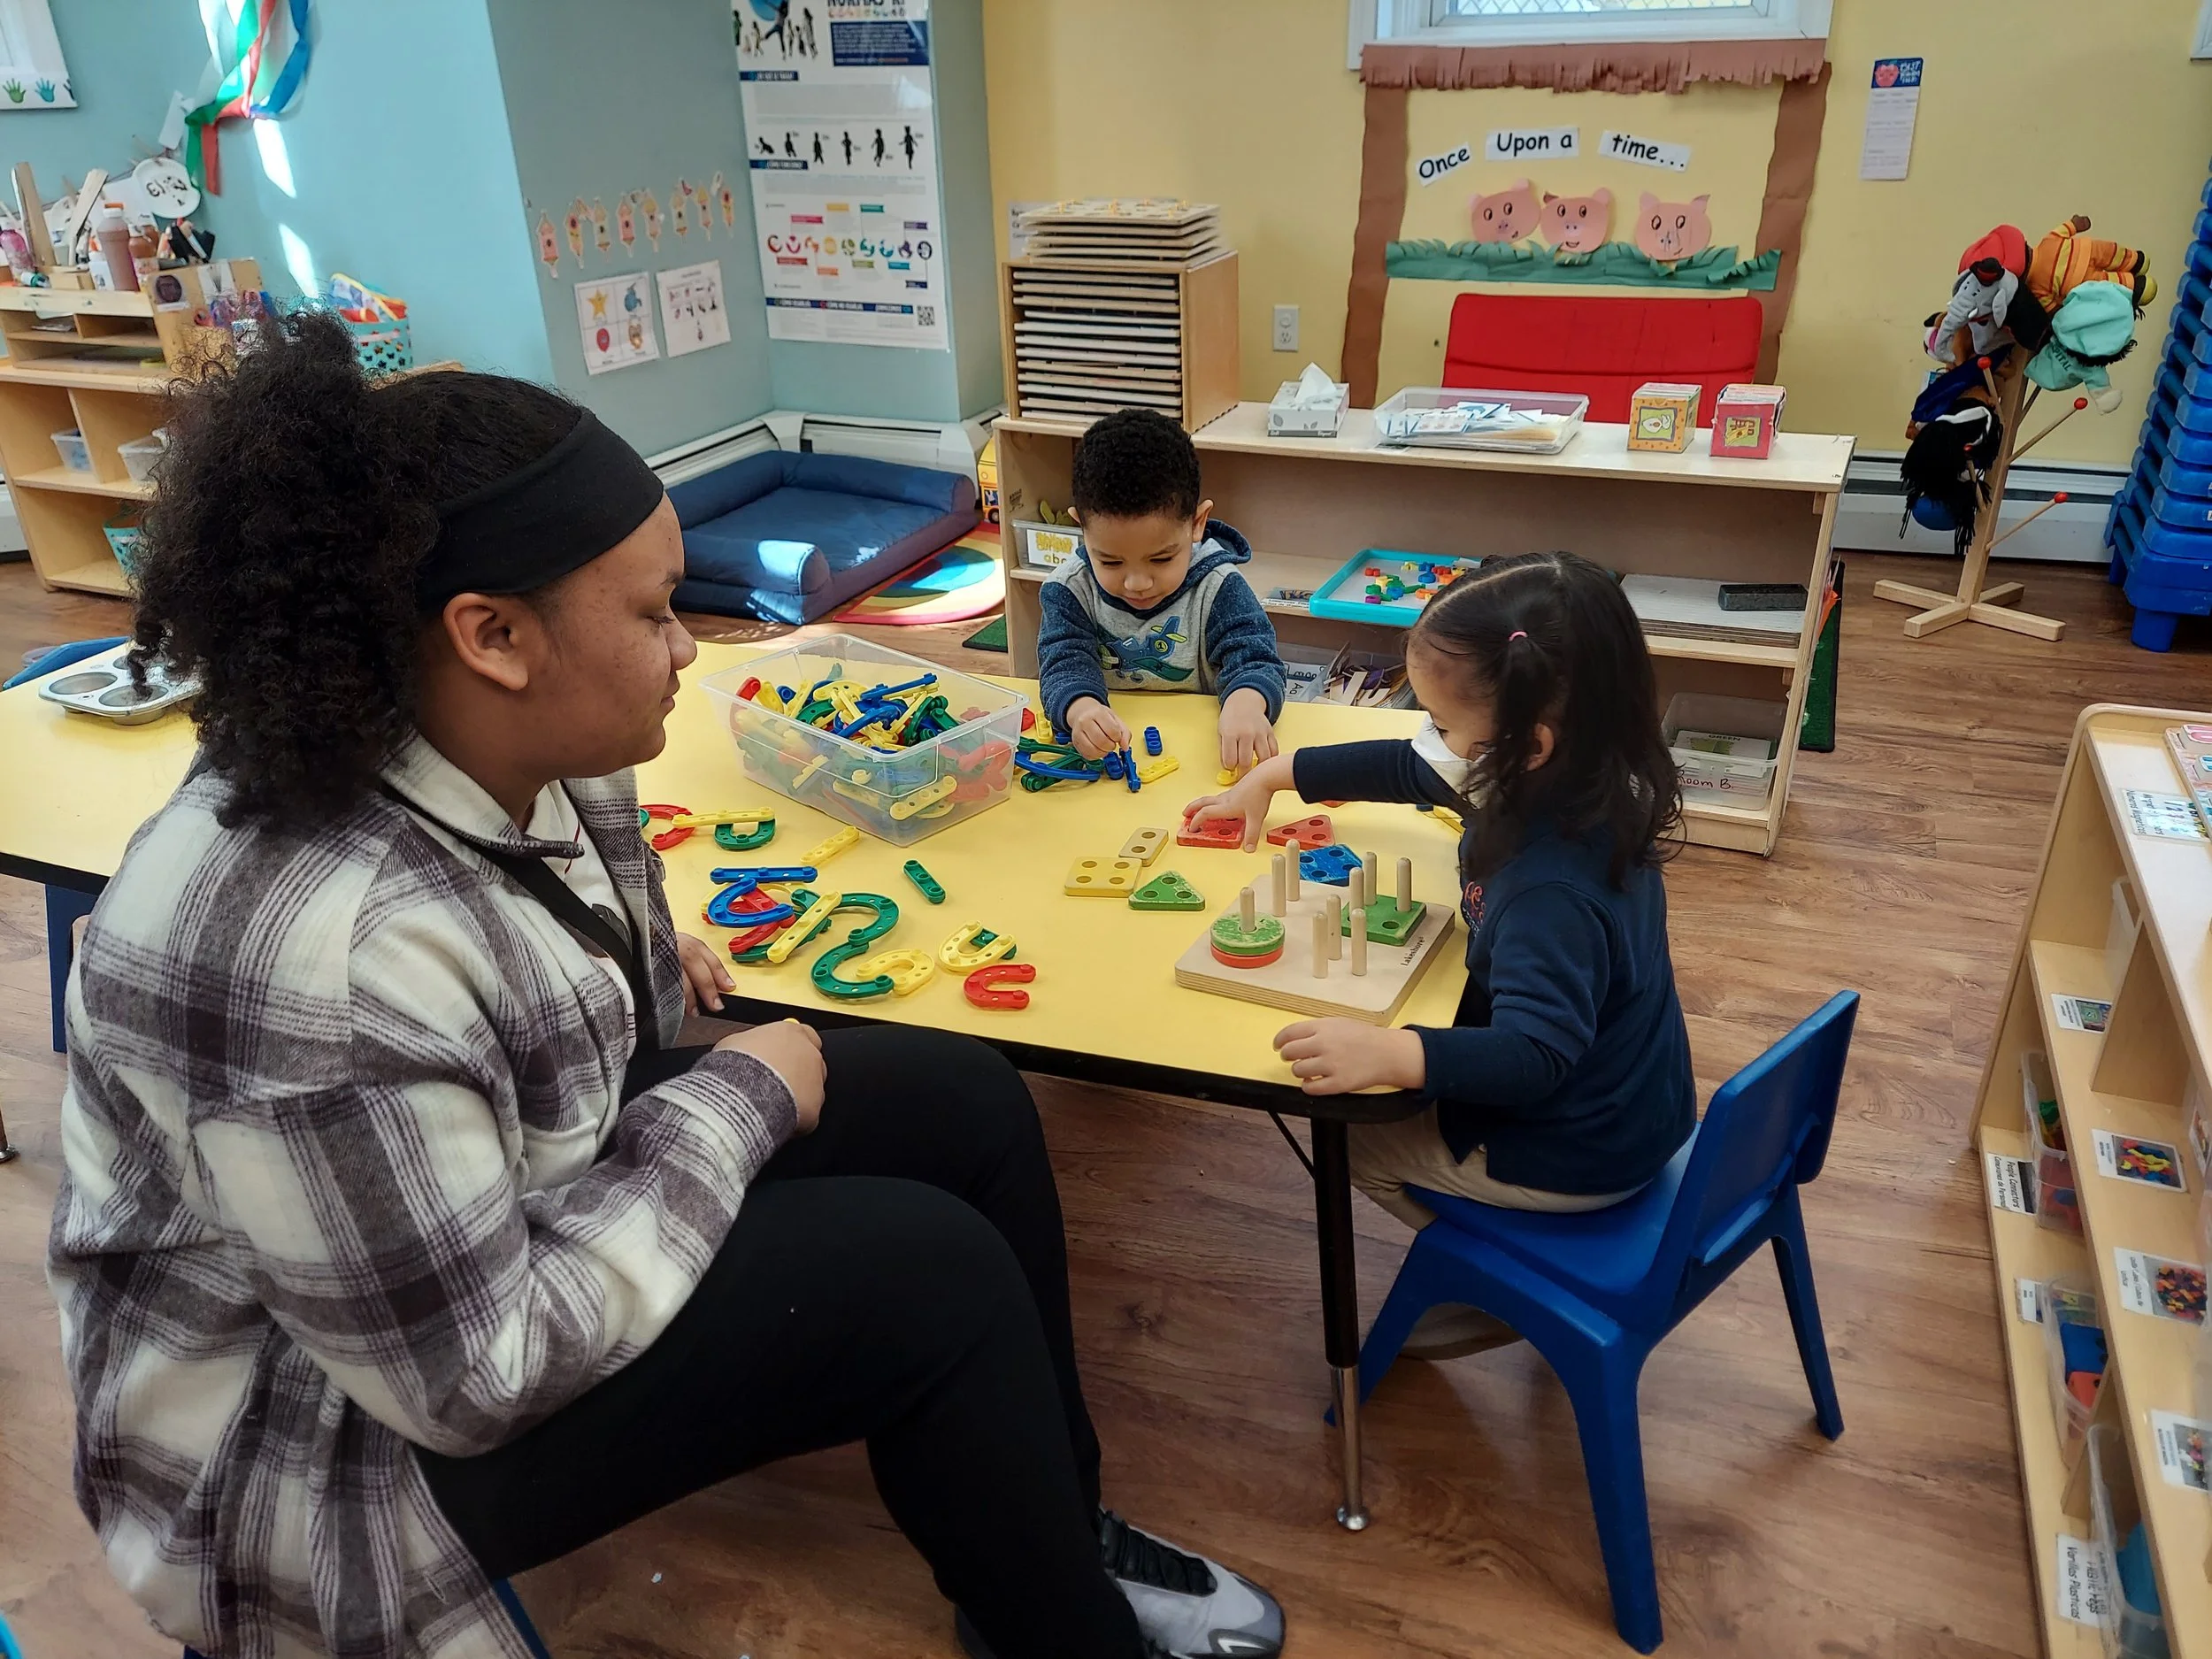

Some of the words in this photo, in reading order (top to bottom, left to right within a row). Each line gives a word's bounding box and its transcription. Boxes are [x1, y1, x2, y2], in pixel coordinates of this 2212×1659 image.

[1418, 146, 1471, 180] Once
[1496, 132, 1550, 157] Upon
[1560, 133, 1573, 150] a
[1611, 133, 1686, 168] time...
[1677, 770, 1714, 788] Room
[2006, 1161, 2016, 1178] People
[2009, 1179, 2020, 1208] Connectors
